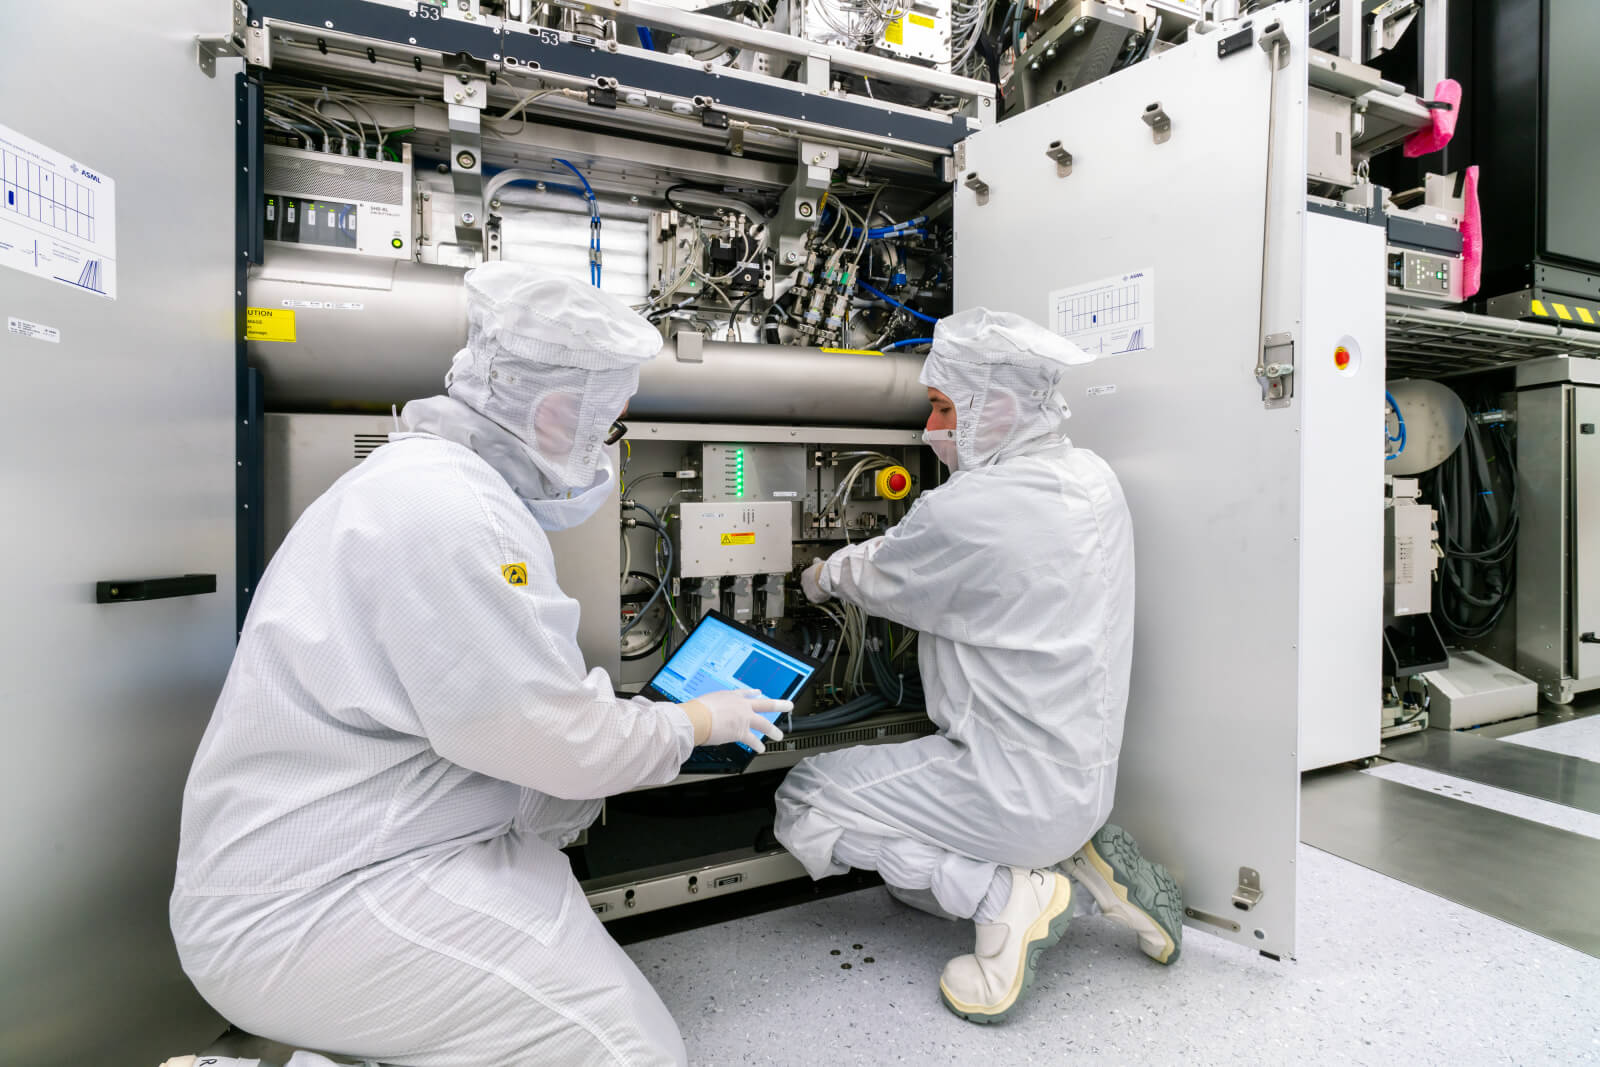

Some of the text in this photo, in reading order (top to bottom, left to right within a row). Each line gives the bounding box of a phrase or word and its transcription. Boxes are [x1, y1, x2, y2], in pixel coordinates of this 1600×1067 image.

[420, 4, 440, 21] 53
[541, 31, 559, 46] 53
[81, 169, 102, 184] ASML
[247, 309, 273, 317] UTION
